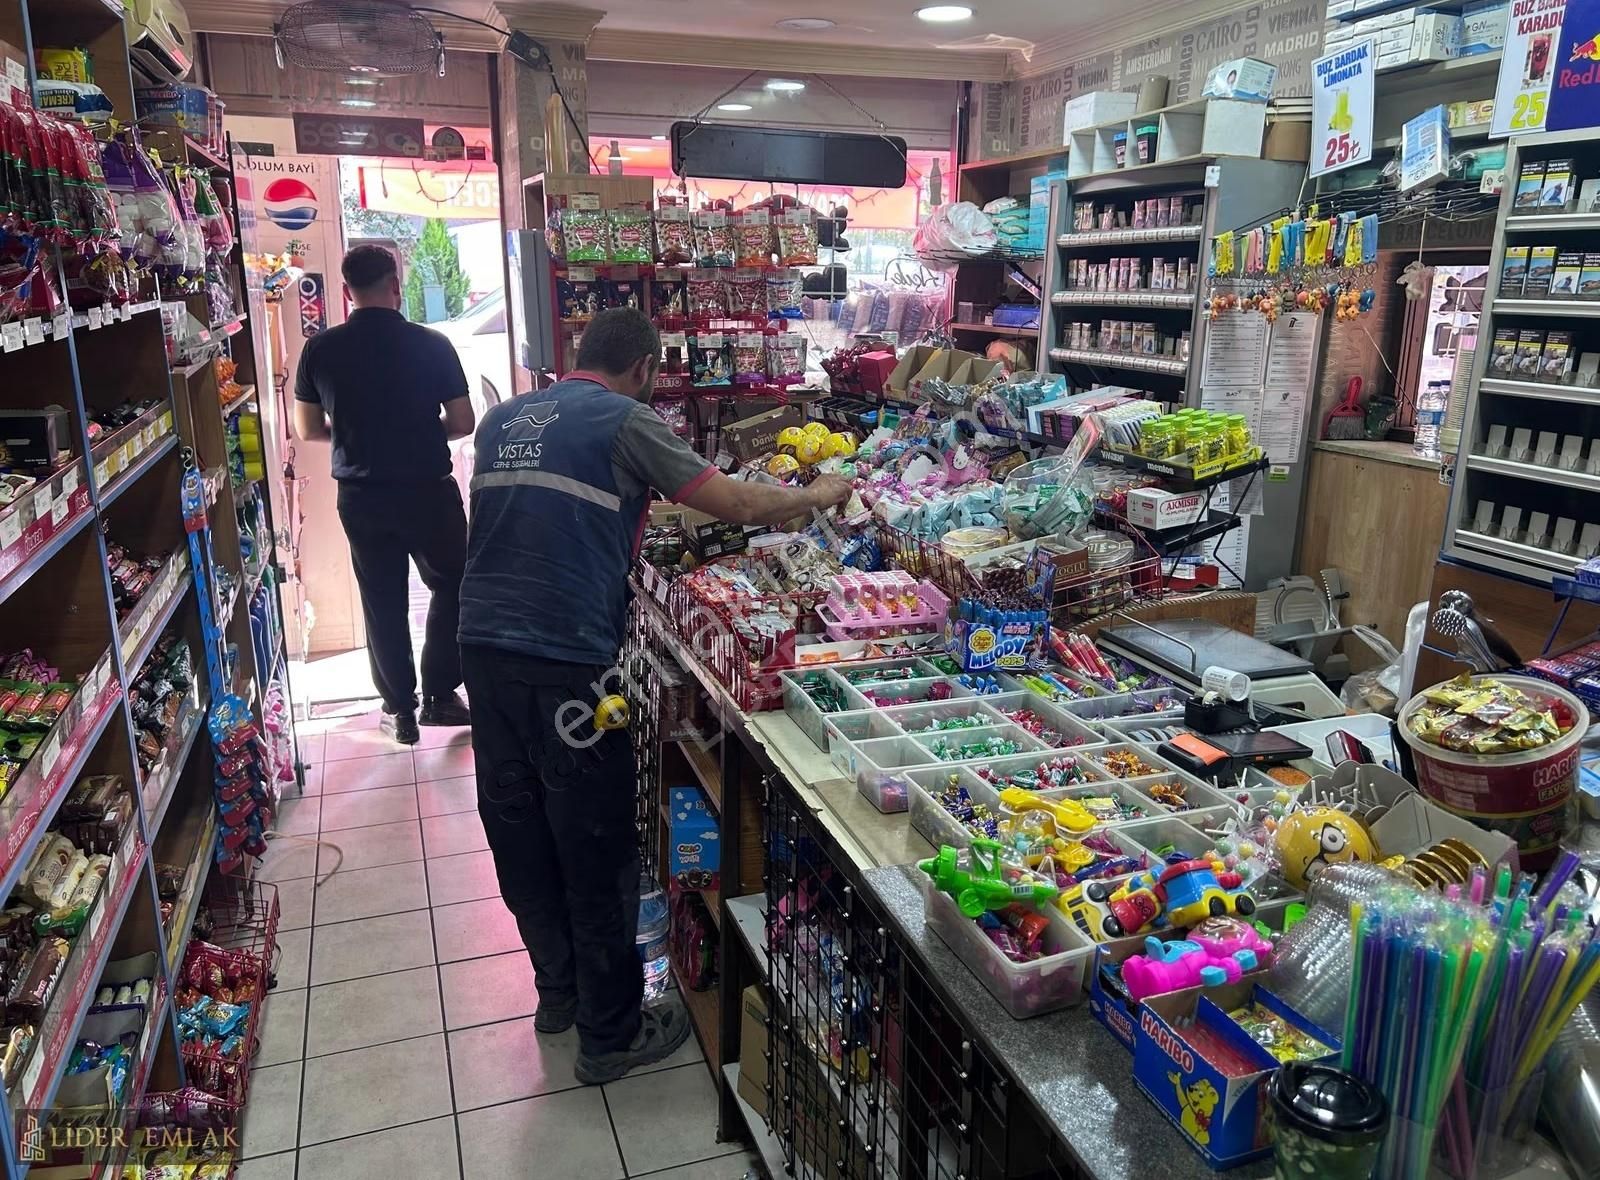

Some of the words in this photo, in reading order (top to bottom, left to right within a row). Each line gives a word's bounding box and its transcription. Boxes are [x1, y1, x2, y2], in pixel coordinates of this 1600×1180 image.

[1267, 3, 1319, 35] VIENNA
[1196, 21, 1242, 53] CAIRO
[1263, 31, 1319, 59] MADRID
[1125, 46, 1172, 76] AMSTERDAM
[1317, 58, 1334, 78] BUZ
[1335, 44, 1369, 71] BARDAK
[1323, 62, 1363, 88] LİMONATA
[1558, 64, 1595, 88] Red
[1033, 78, 1062, 101] CAIRO
[1509, 91, 1548, 129] 25
[1147, 462, 1175, 475] mentos
[969, 636, 1027, 669] MELODY
[996, 656, 1025, 666] POPS
[1140, 1010, 1194, 1074] HARIBO
